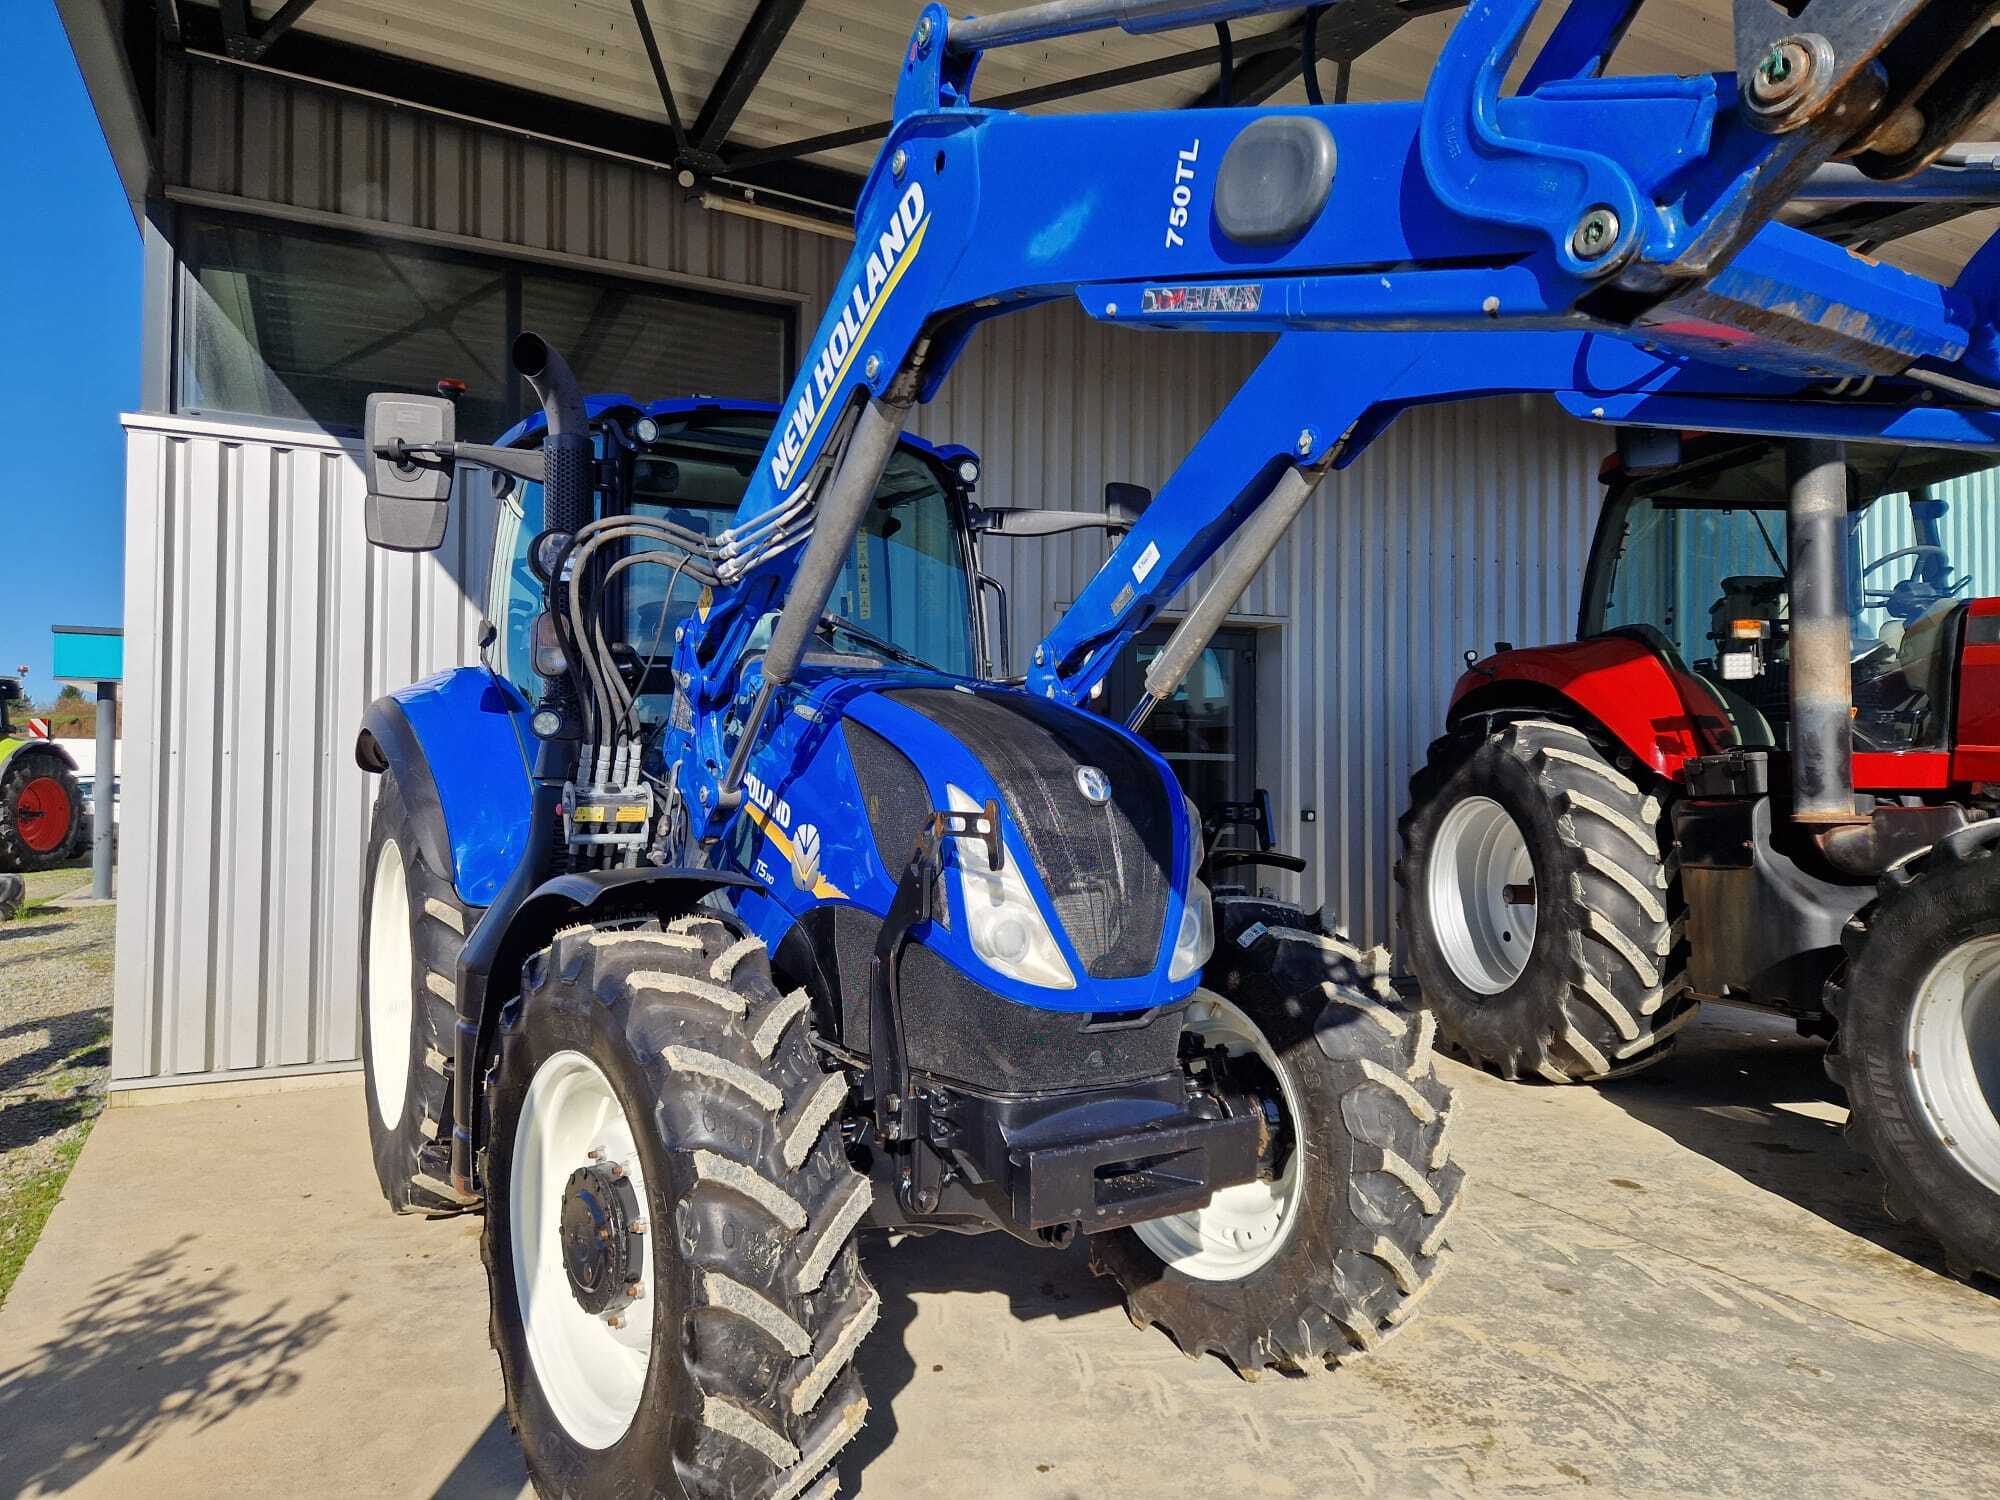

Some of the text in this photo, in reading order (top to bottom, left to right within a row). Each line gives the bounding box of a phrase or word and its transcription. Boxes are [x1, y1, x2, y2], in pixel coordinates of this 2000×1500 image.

[1165, 138, 1200, 248] 750TL
[771, 181, 925, 489] NEW HOLLAND
